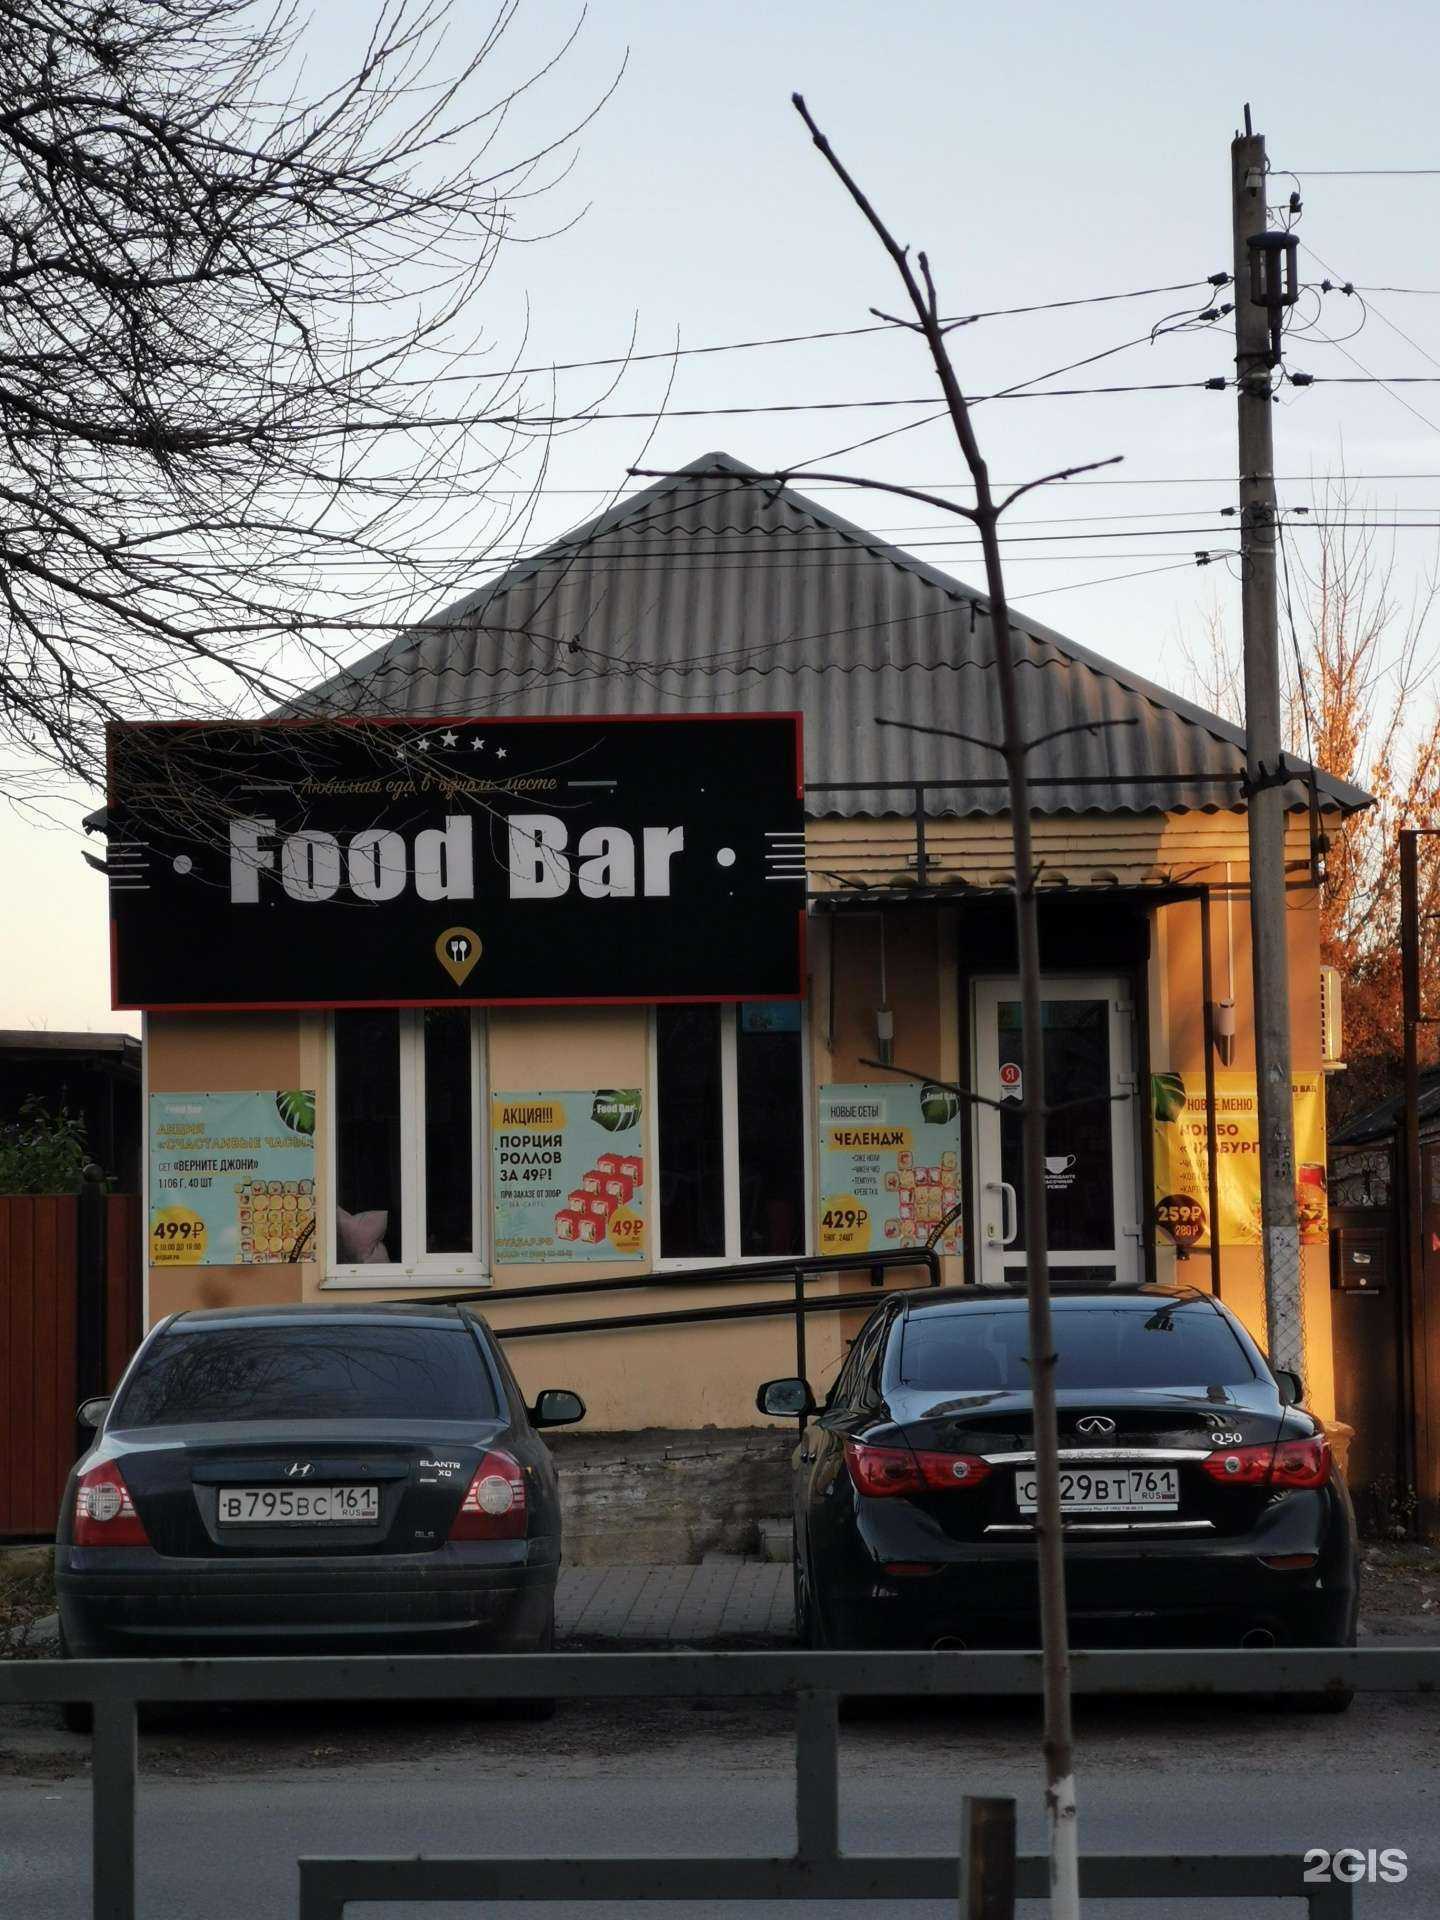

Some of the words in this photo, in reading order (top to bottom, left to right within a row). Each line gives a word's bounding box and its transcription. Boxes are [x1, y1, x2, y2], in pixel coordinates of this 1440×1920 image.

[384, 780, 415, 800] еда
[503, 777, 557, 793] месте
[229, 814, 474, 904] Food
[508, 813, 685, 899] Bar
[830, 1105, 857, 1118] НОВЫЕ
[857, 1104, 879, 1118] СЕТЫ
[1186, 1098, 1220, 1111] НОВЕ
[1221, 1097, 1253, 1111] МЕНЮ
[502, 1108, 553, 1125] АКЦИЯ!!!
[499, 1134, 563, 1149] ПОРЦИЯ
[834, 1132, 904, 1146] ЧЕЛЕНДЖ
[173, 1160, 218, 1172] «ВЕРНИТЕ
[219, 1158, 259, 1172] ДЖОНИ»
[500, 1151, 562, 1165] РОЛЛОВ
[499, 1170, 518, 1182] ЗА
[1211, 1432, 1243, 1445] Q50
[1024, 1474, 1127, 1501] С29ВТ
